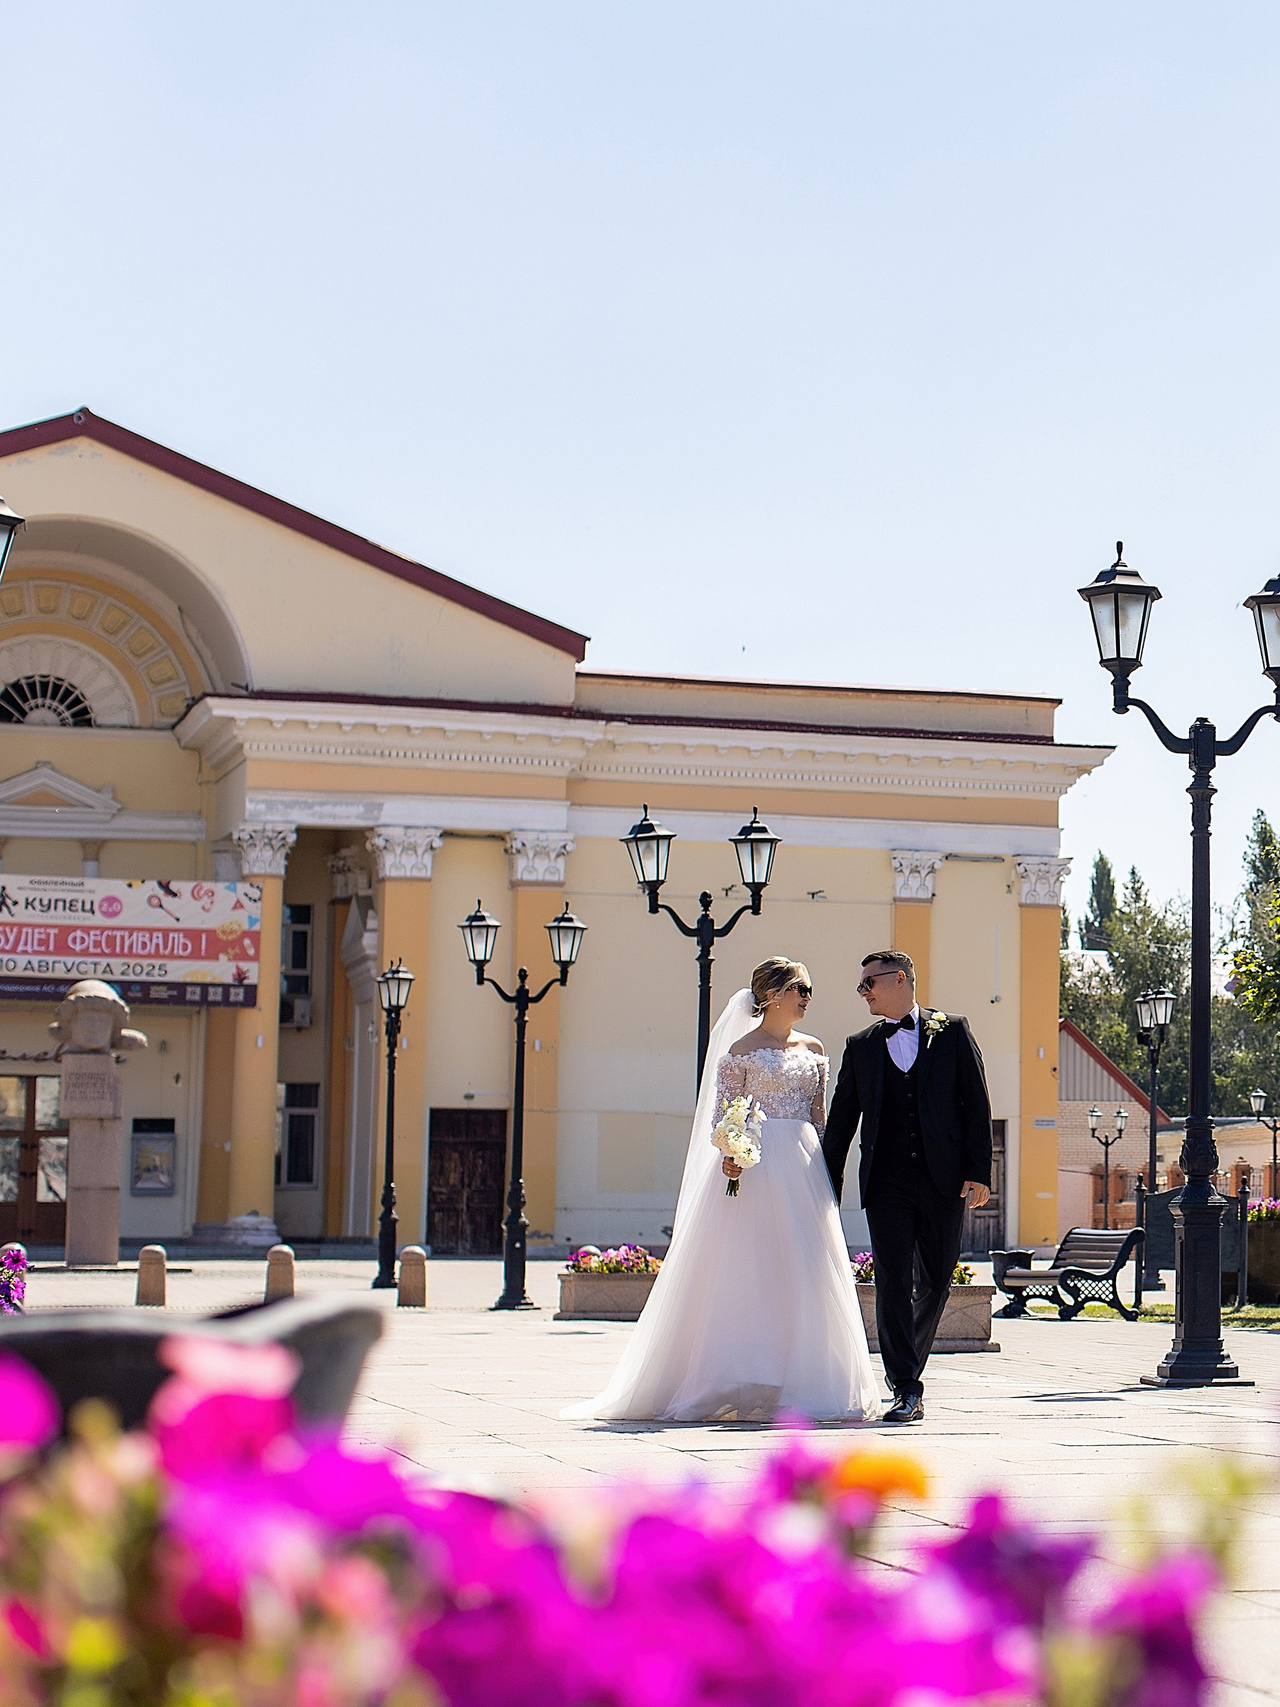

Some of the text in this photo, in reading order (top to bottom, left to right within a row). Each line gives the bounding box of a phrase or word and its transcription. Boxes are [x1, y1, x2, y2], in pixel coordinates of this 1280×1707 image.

[29, 879, 85, 887] ЮБИЛЕЙНЫЙ
[24, 896, 121, 916] КУПЕЦ 2.0
[67, 929, 192, 956] ФЕСТИВАЛЬ
[22, 959, 114, 976] АВГУСТА
[120, 961, 168, 977] 2025
